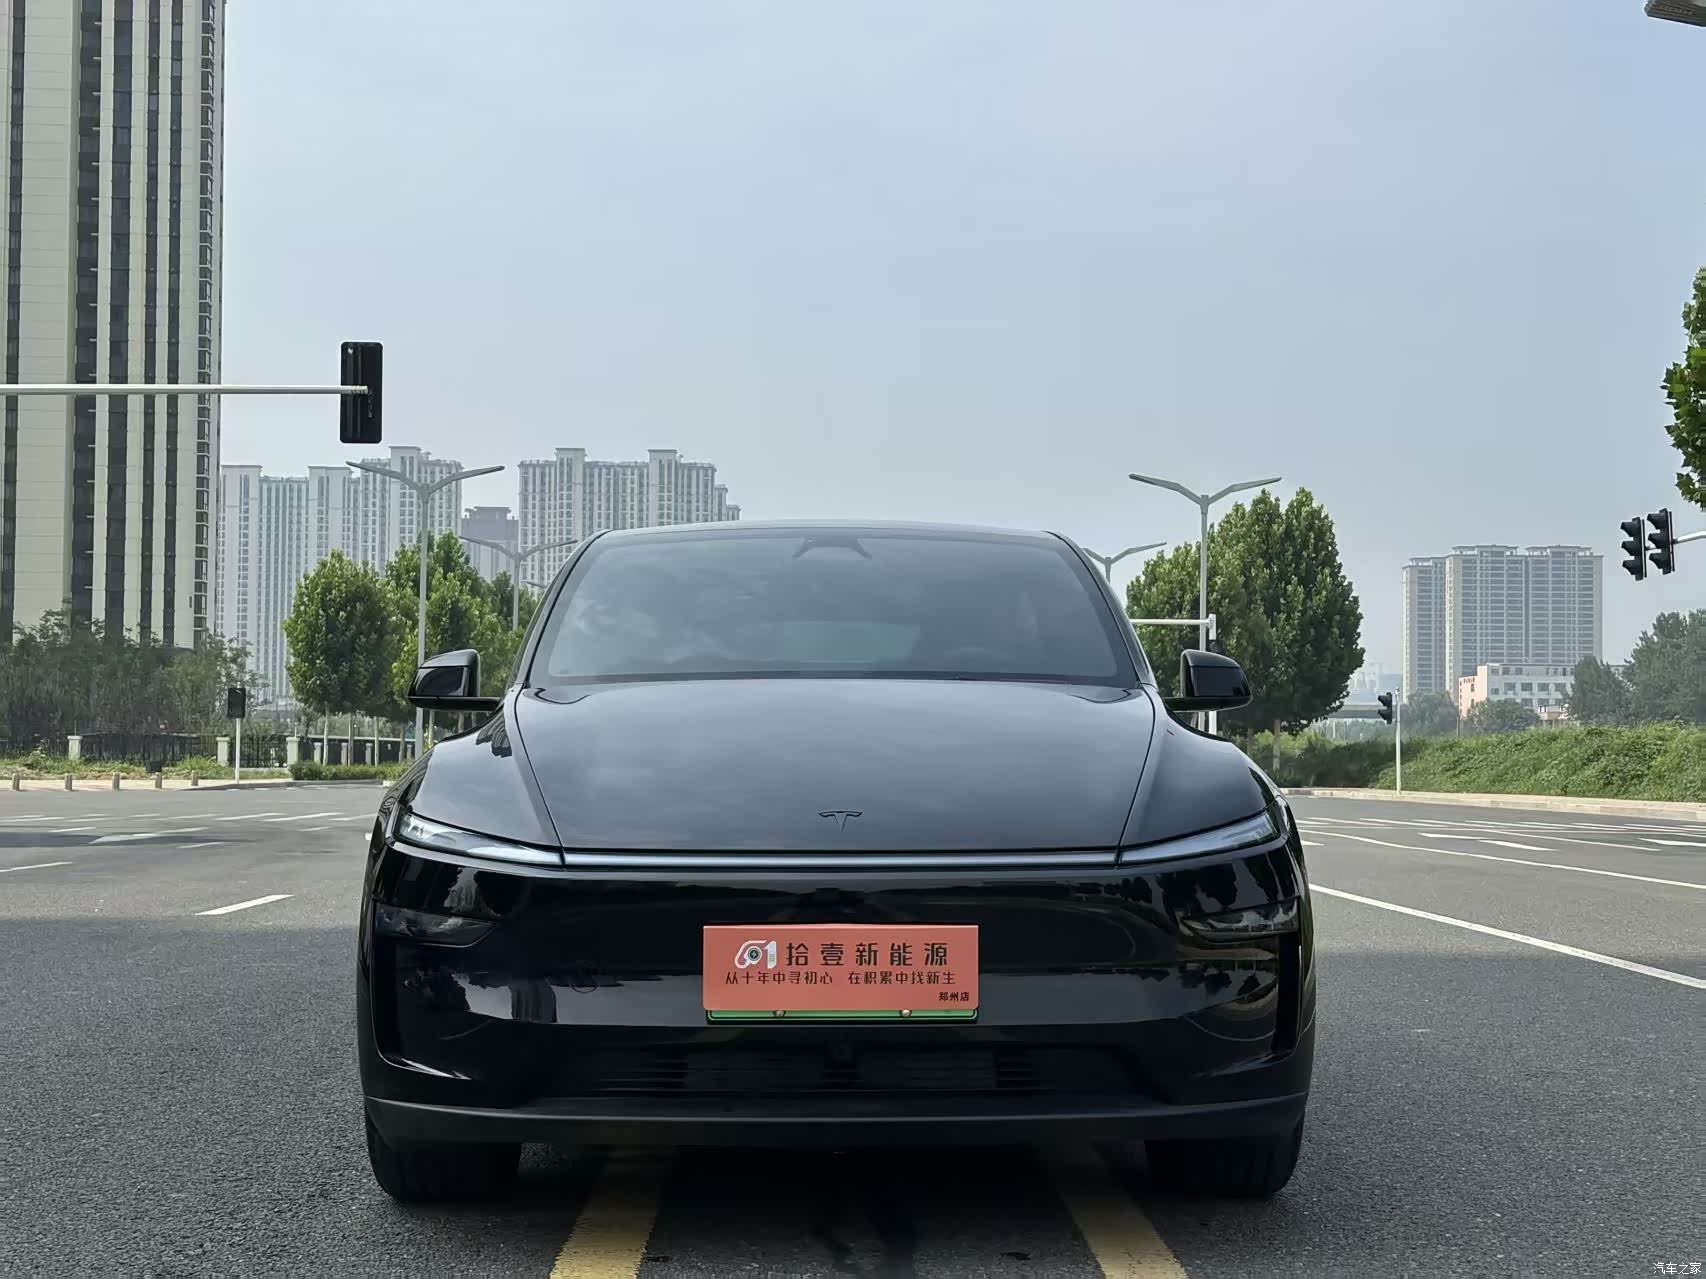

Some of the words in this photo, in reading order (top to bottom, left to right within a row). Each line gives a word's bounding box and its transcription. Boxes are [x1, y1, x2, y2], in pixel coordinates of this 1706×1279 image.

[786, 942, 949, 966] 拾壹新能源
[725, 971, 833, 985] 从十年中寻初心
[847, 971, 956, 985] 在积累中找新生
[938, 991, 970, 1002] 郑州店
